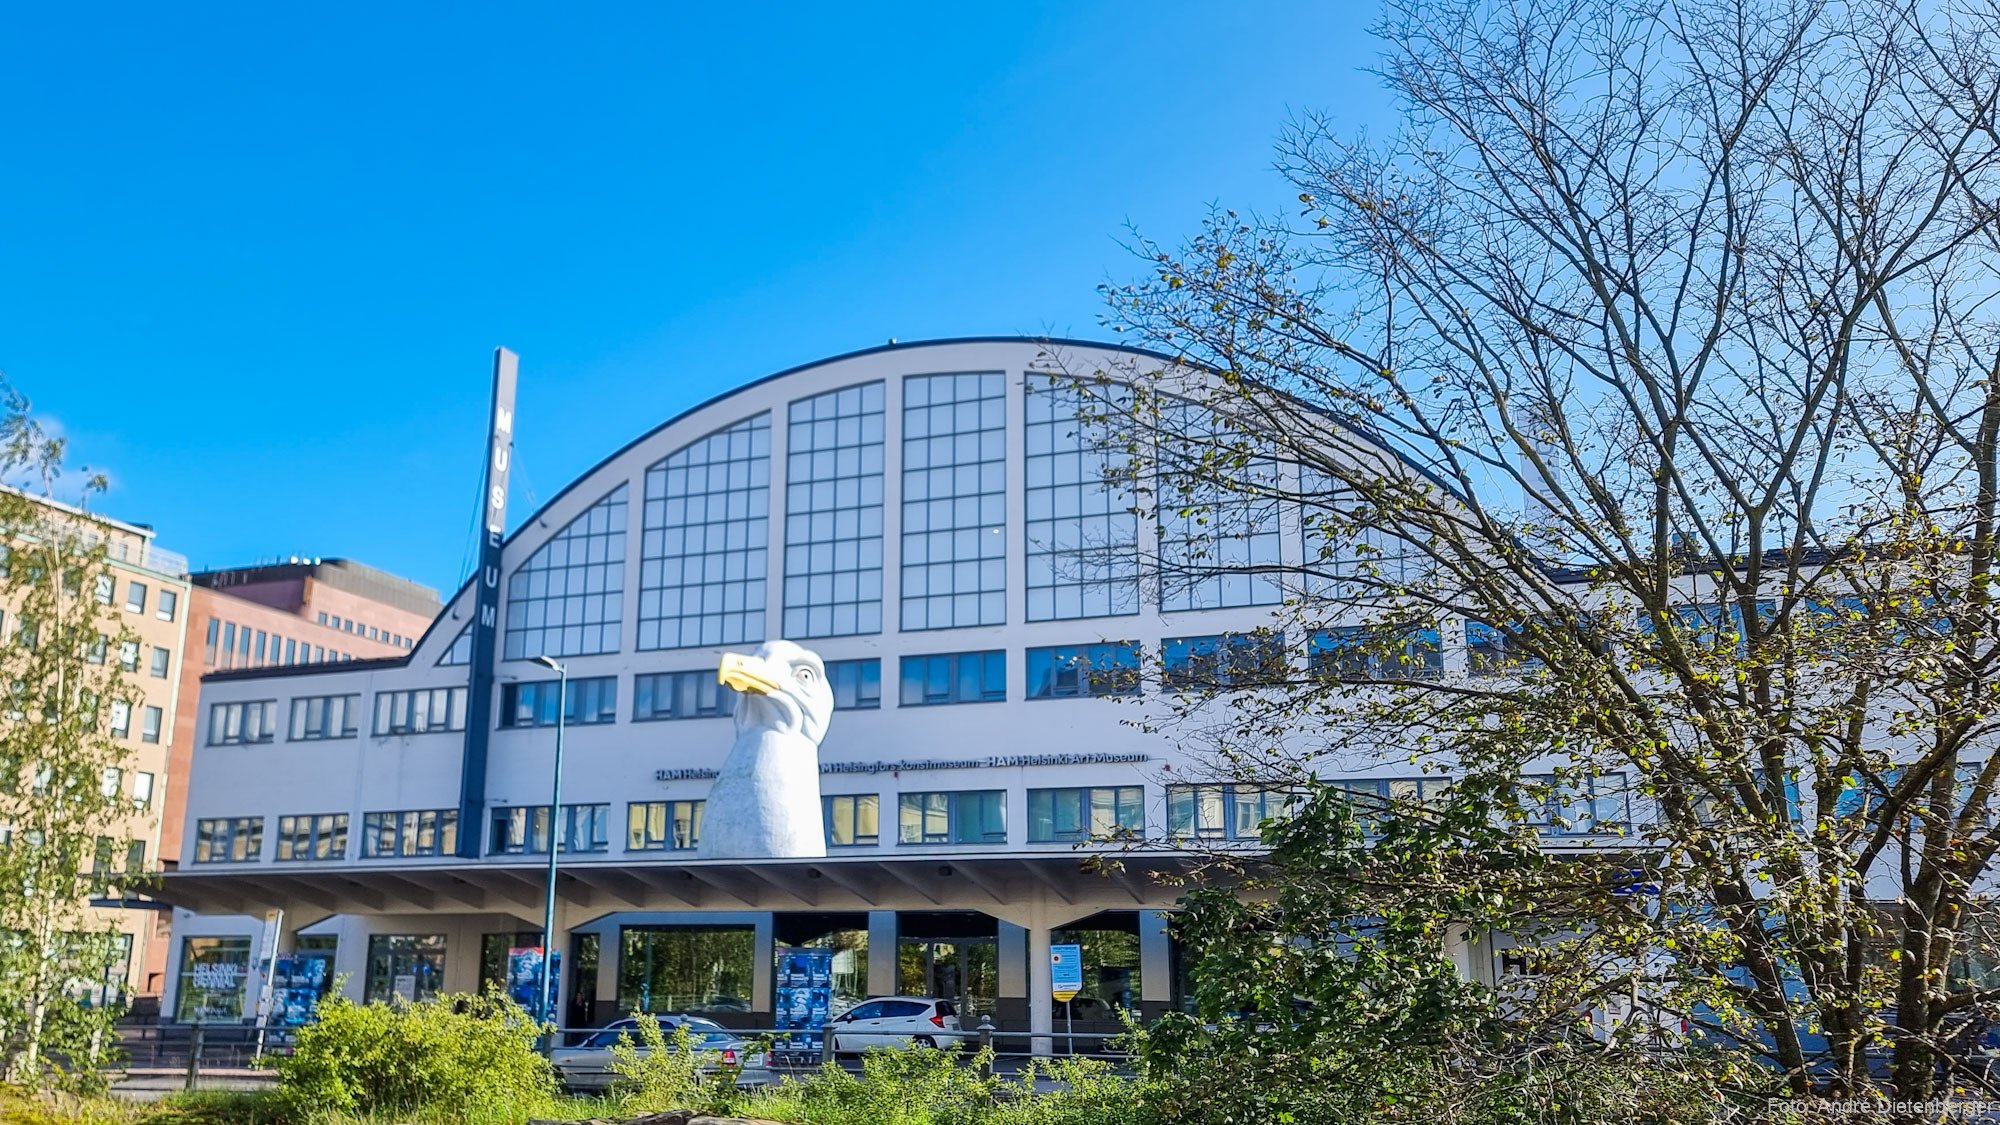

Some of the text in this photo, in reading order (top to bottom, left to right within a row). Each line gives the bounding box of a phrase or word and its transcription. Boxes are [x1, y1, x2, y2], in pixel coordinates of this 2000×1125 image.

[481, 407, 512, 628] MUSEUM
[656, 767, 685, 780] HAM
[836, 761, 898, 775] Helsingfors
[988, 755, 1020, 768] HAM
[1022, 754, 1069, 767] Helsinki
[1071, 753, 1092, 765] Art
[1094, 752, 1149, 764] Museum
